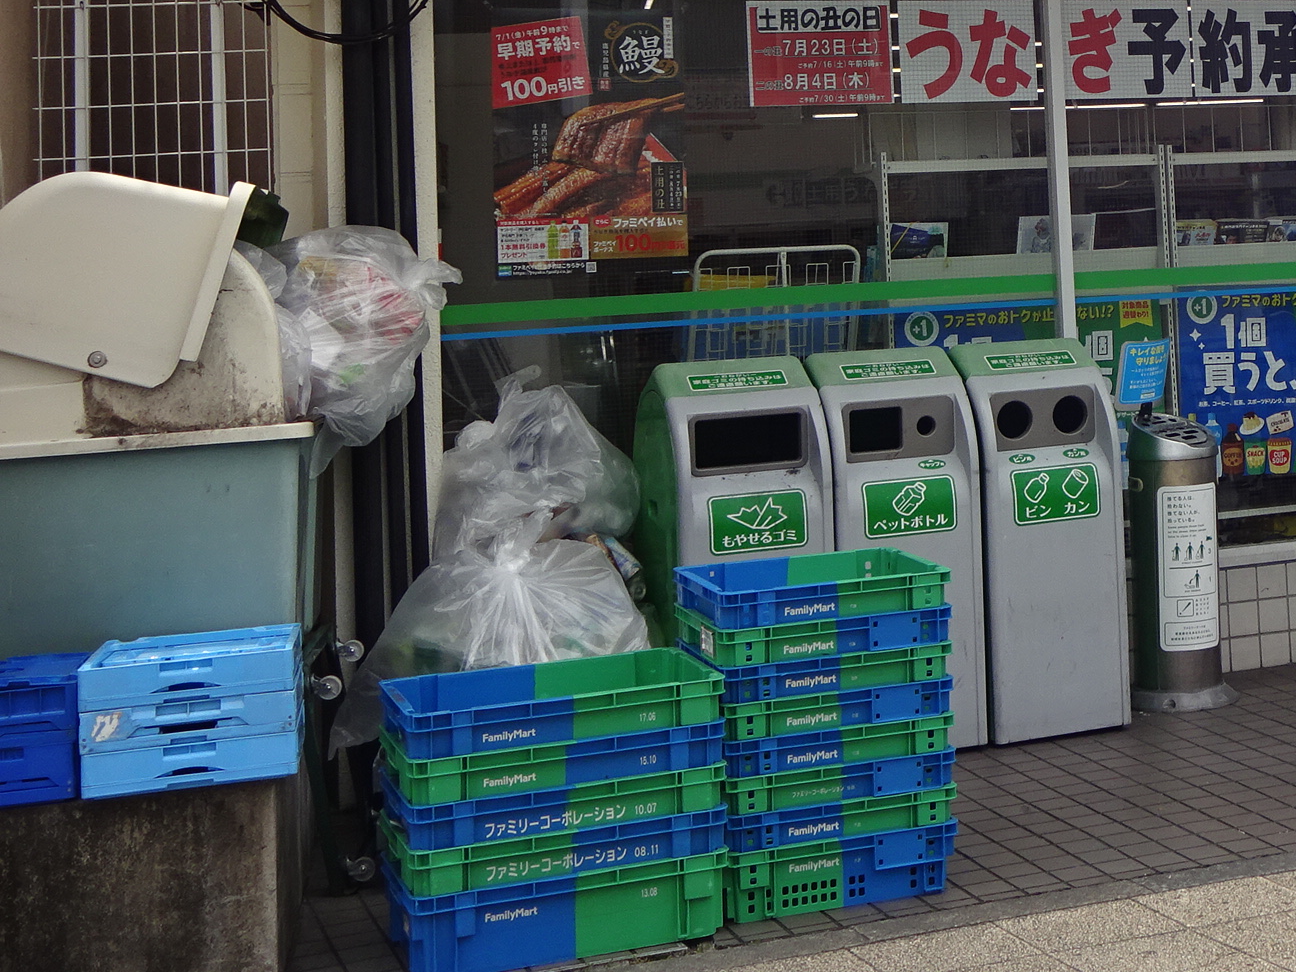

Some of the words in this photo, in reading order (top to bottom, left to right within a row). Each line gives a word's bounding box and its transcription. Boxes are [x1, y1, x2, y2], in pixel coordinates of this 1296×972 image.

[758, 6, 880, 31] 土用の丑の日
[497, 35, 581, 60] 早期予約で
[618, 35, 665, 75] 鰻
[501, 76, 586, 101] 100円引き
[613, 217, 684, 228] ファミペイ払いで
[943, 305, 1114, 329] ファミマのおトクが止ない!?
[1220, 313, 1267, 349] 1個
[1246, 449, 1265, 458] SNACK
[1271, 456, 1288, 464] SOUP
[1273, 450, 1286, 458] CUP
[1025, 504, 1052, 519] ビン
[1064, 501, 1091, 514] カン
[873, 513, 949, 531] ペットボトル
[721, 530, 797, 548] もやせるゴミ
[784, 602, 836, 616] FamilyMart
[783, 640, 834, 655] FamilyMart
[785, 674, 836, 688] FamilyMart
[786, 712, 837, 726] FamilyMart
[482, 728, 536, 743] FamilyMart
[787, 749, 838, 764] FamilyMart
[483, 772, 537, 788] FamilyMart
[639, 755, 657, 765] 15.10
[485, 804, 626, 838] ファミリーコーポレーション
[634, 802, 657, 815] 10.07
[788, 821, 839, 837] FamilyMart
[486, 846, 627, 881] ファミリーコーポレーション
[634, 845, 659, 857] 08.11
[789, 857, 840, 873] FamilyMart
[484, 907, 538, 923] FamilyMart
